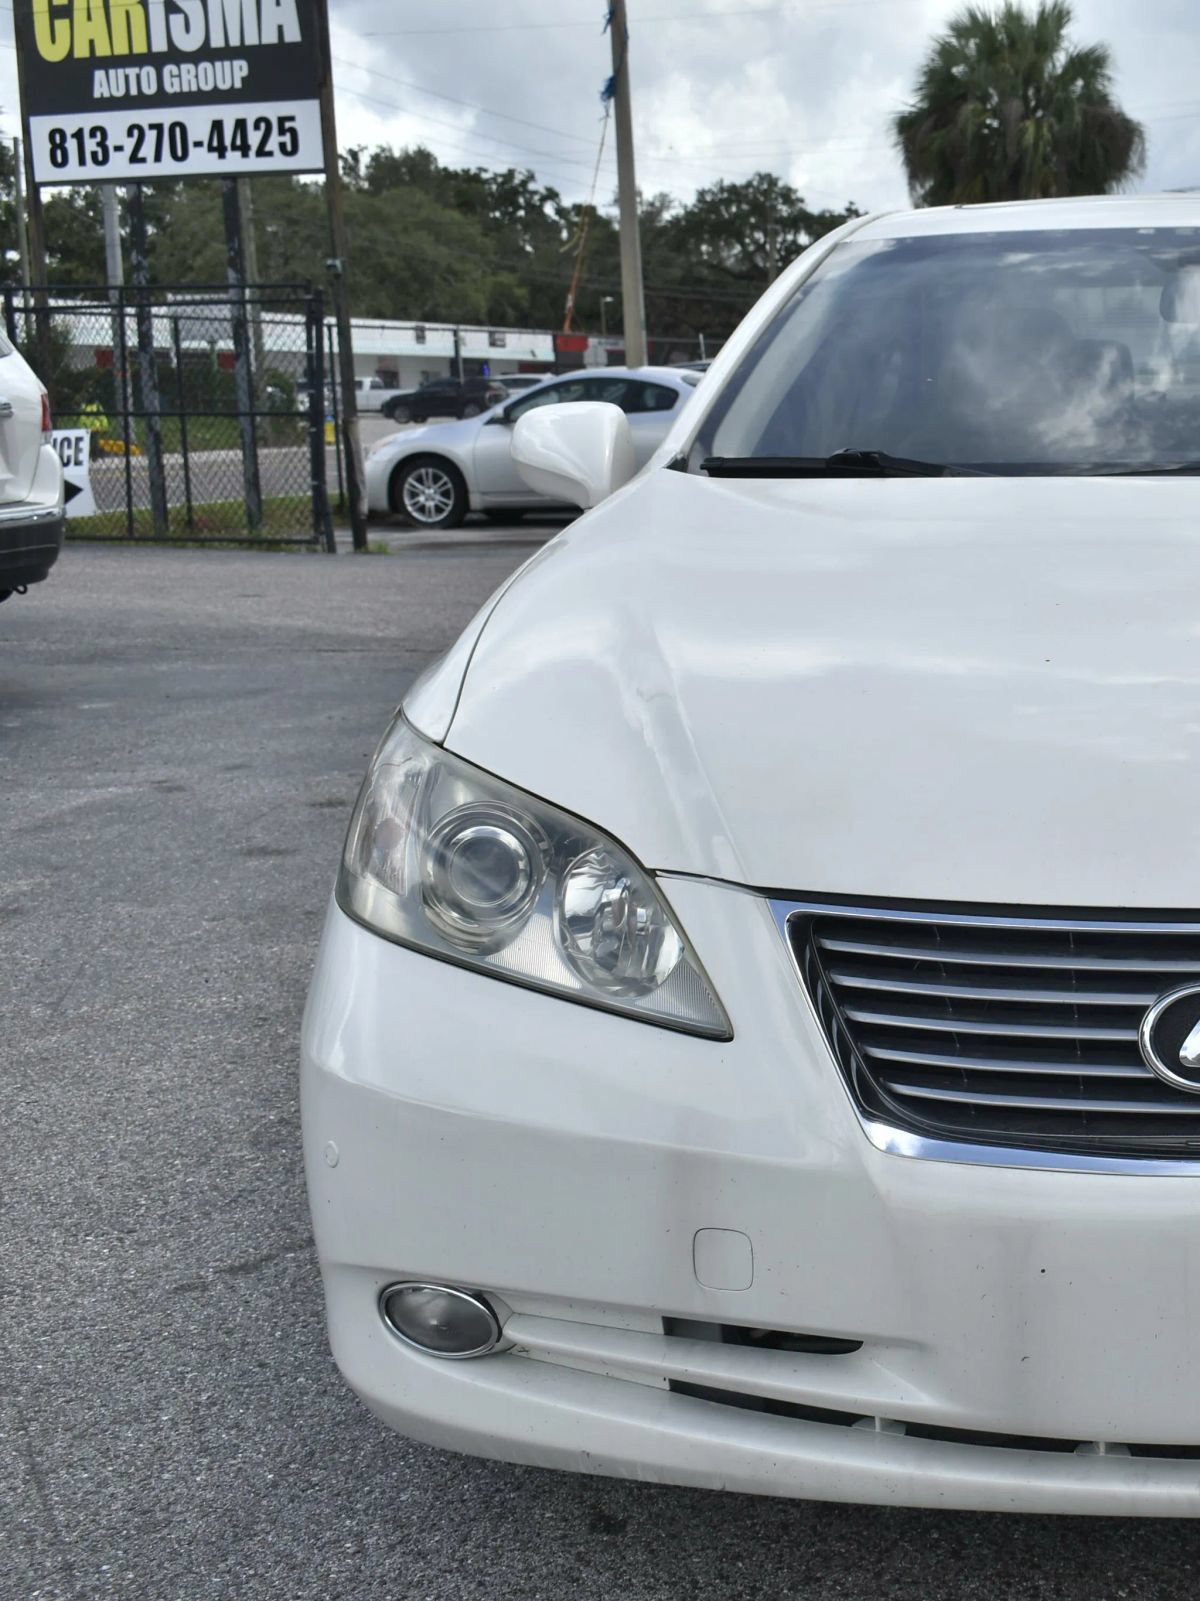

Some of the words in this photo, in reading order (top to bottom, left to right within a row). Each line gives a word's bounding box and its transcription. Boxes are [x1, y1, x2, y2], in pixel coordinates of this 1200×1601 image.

[32, 0, 302, 62] CARISMA
[93, 66, 157, 98] AUTO
[162, 59, 249, 94] GROUP
[48, 115, 299, 169] 813-270-4425
